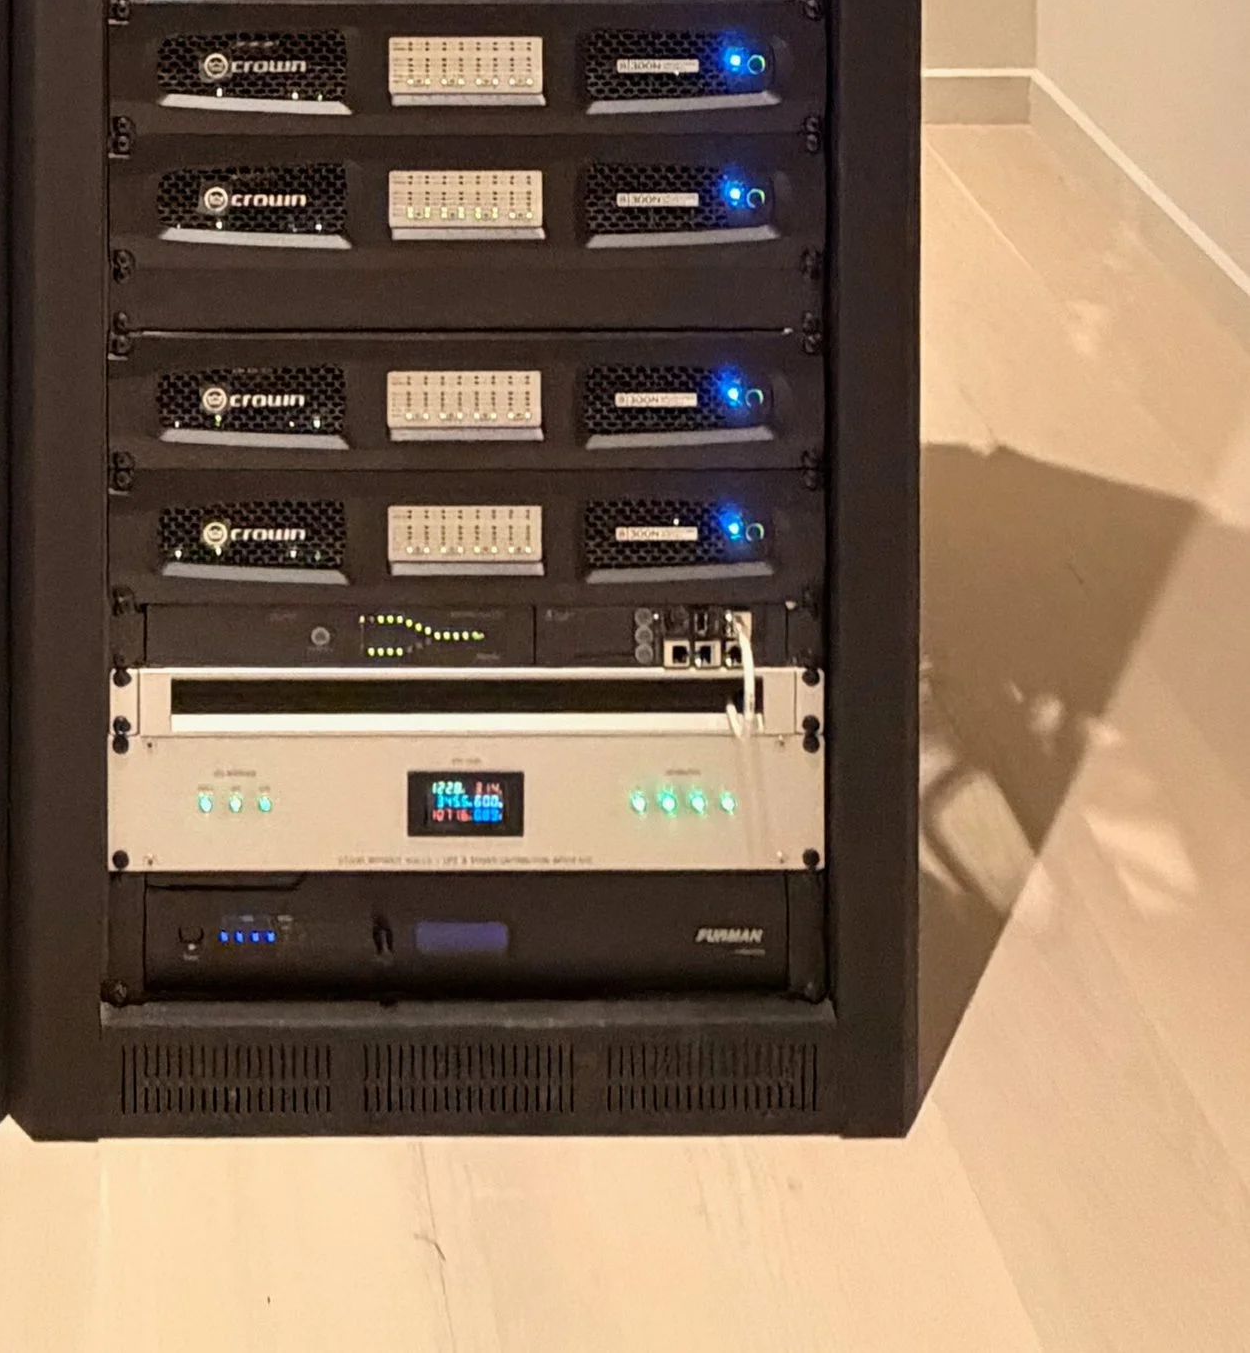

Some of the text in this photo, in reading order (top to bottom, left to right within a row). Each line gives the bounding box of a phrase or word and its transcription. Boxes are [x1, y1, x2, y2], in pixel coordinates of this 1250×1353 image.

[231, 59, 307, 73] crown
[231, 193, 307, 208] crown
[229, 393, 306, 408] crown
[230, 527, 306, 542] crown
[694, 928, 764, 943] FURMAN
